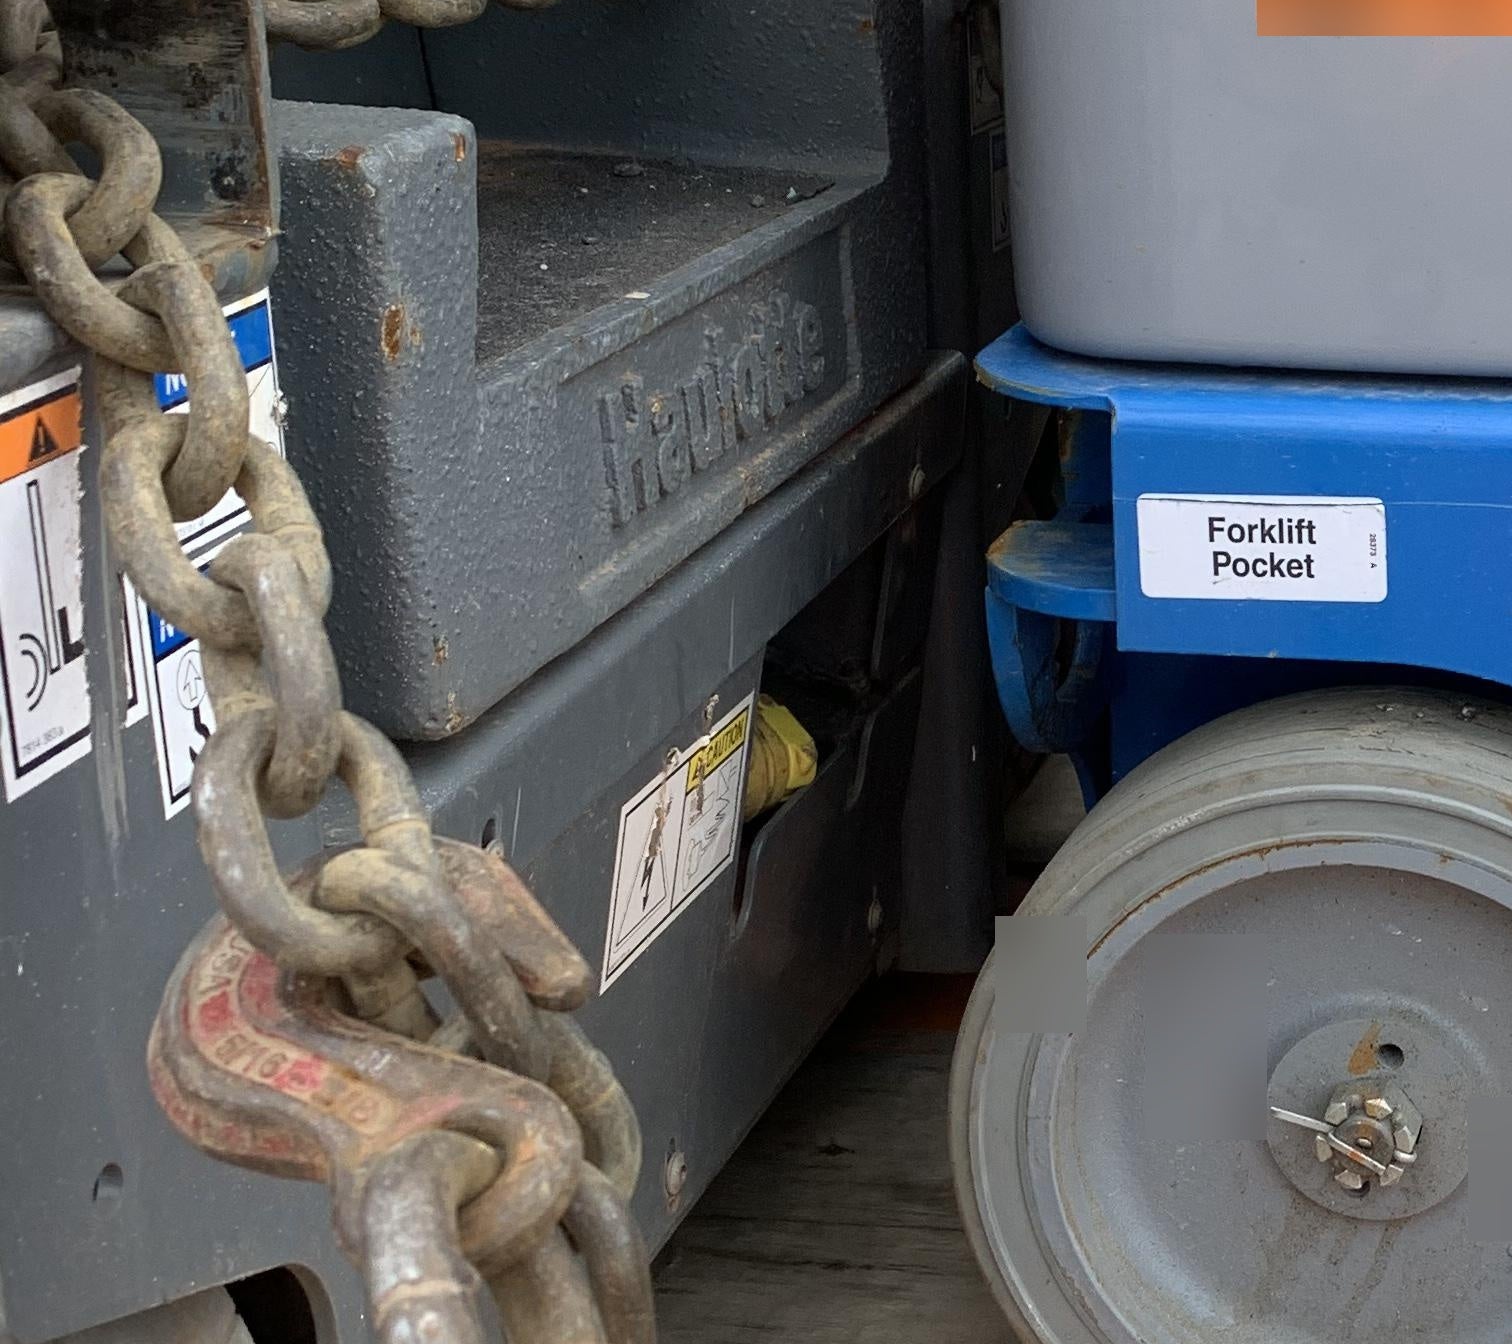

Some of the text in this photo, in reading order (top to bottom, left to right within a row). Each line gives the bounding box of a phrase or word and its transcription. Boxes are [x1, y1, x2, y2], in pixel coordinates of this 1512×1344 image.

[1207, 516, 1317, 545] Forklift
[1212, 550, 1316, 579] Pocket
[706, 717, 745, 767] CAUTION
